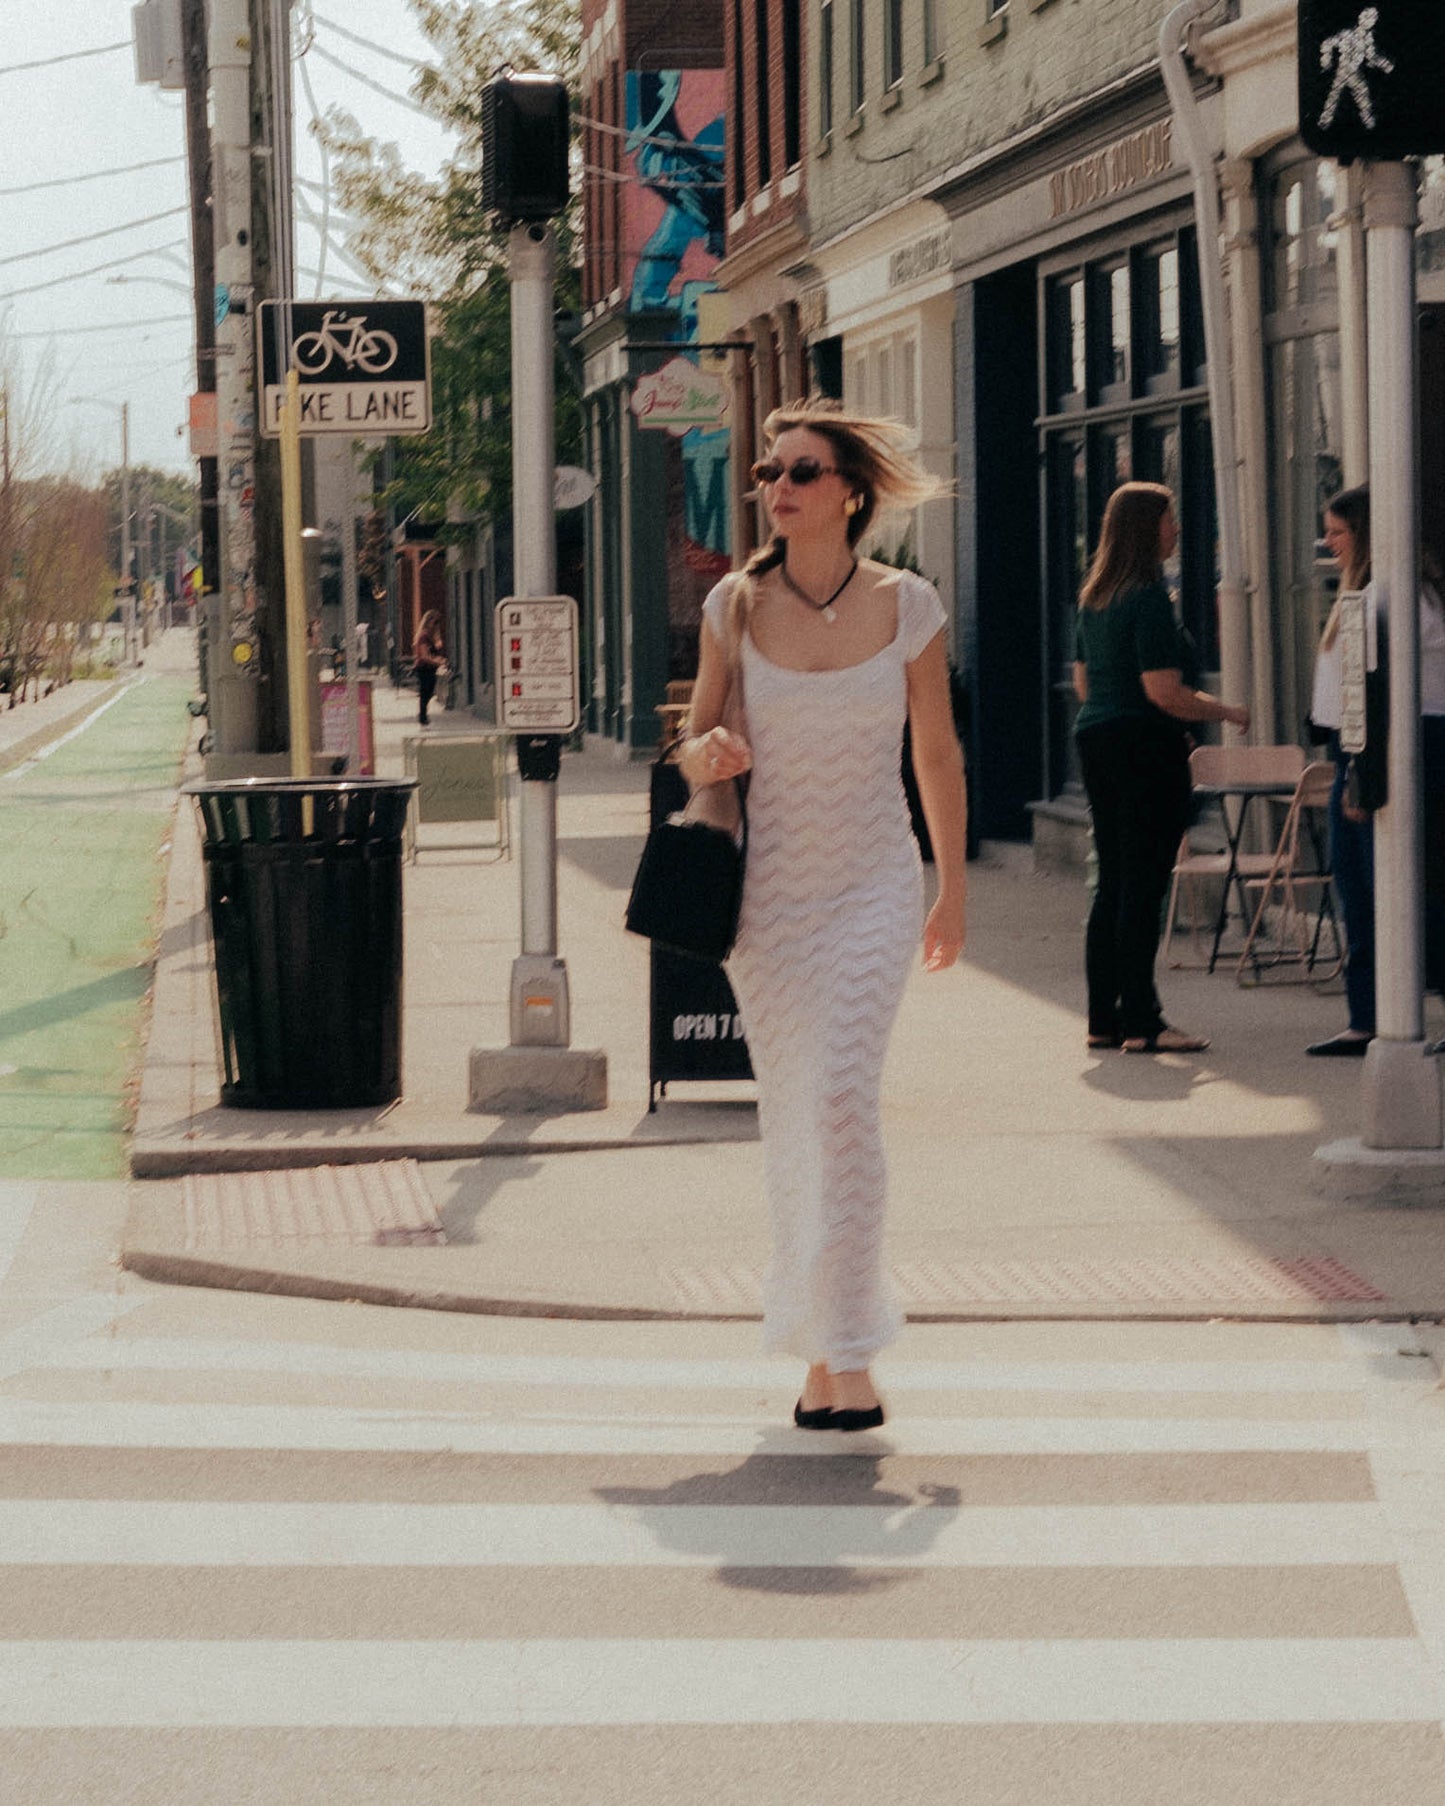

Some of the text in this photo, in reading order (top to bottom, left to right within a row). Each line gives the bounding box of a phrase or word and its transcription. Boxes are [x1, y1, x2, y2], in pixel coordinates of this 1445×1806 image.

[275, 390, 417, 422] KE LANE
[673, 1013, 717, 1040] OPEN
[718, 1013, 731, 1040] 7
